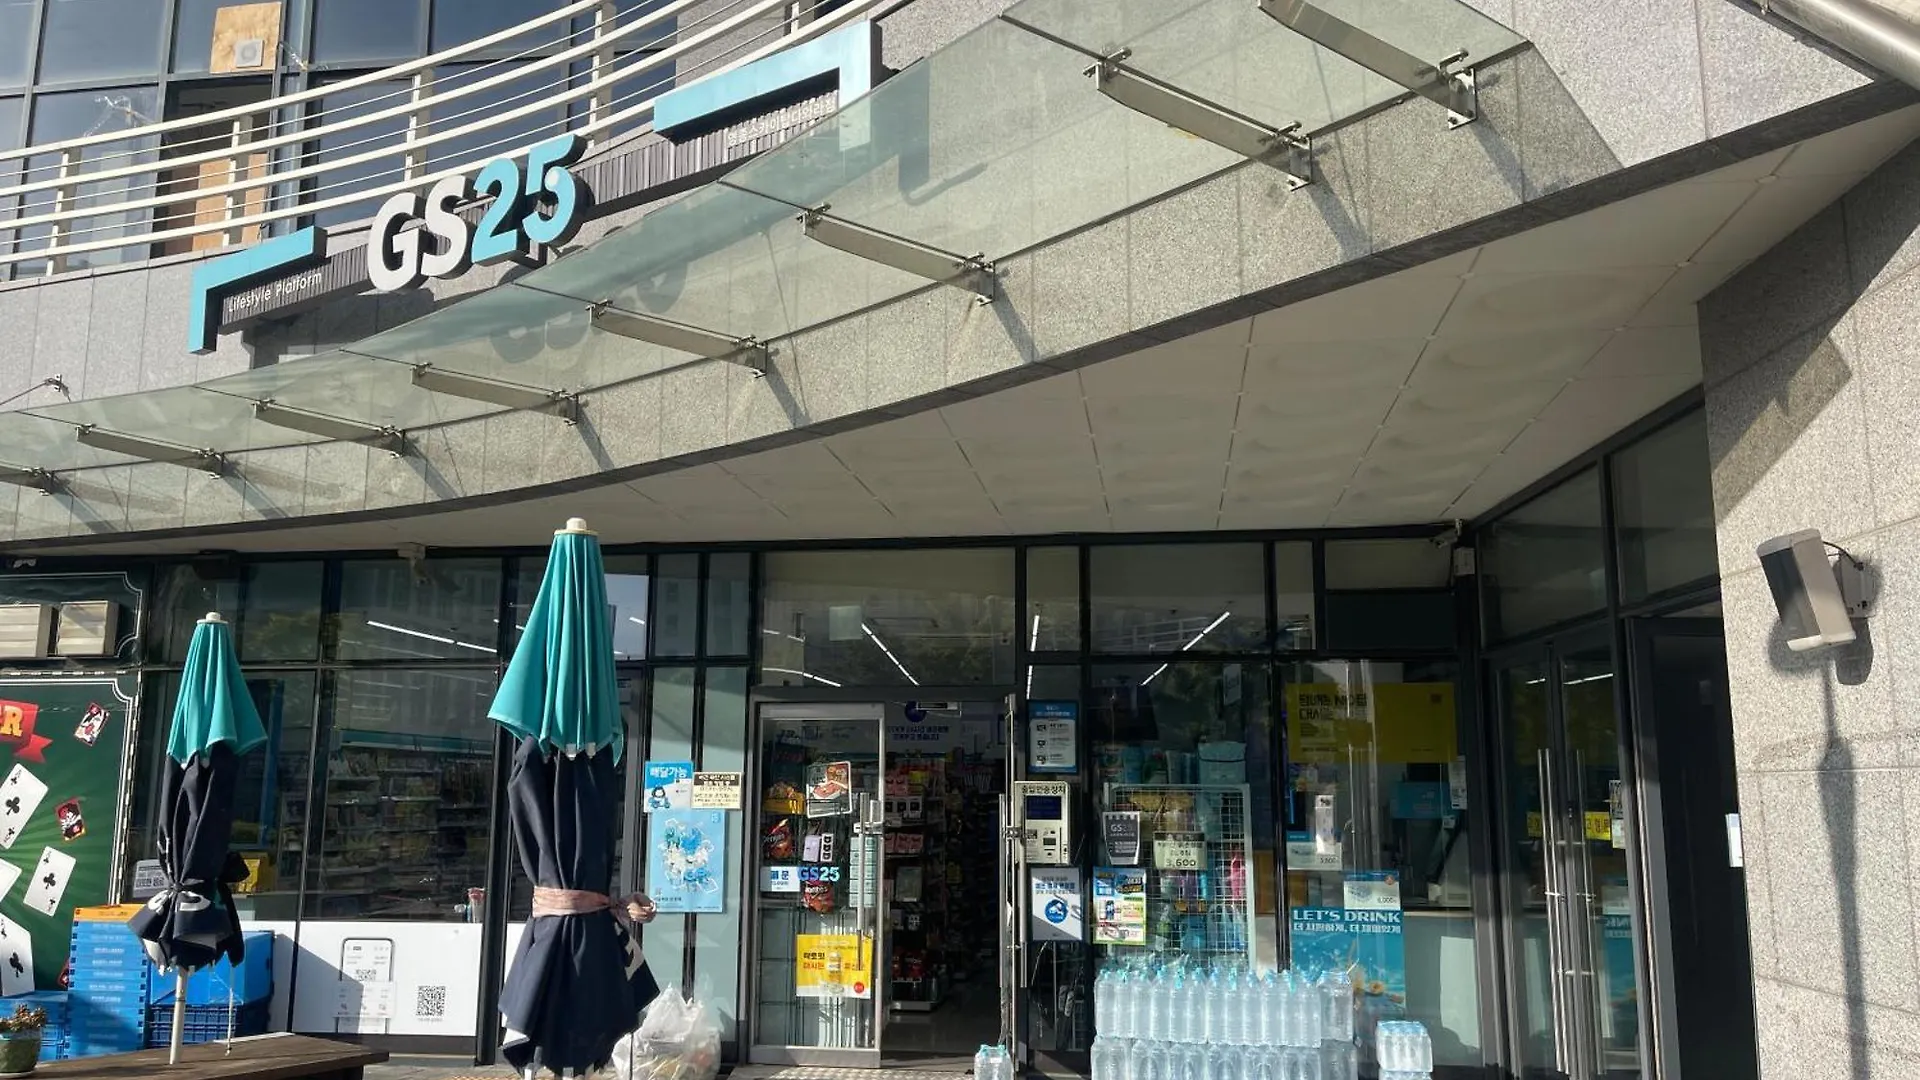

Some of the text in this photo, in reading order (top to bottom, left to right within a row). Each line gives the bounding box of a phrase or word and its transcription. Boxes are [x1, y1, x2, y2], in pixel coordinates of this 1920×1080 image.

[367, 133, 577, 292] GS25
[228, 272, 322, 312] Lifestyle Platform
[0, 704, 23, 737] R
[650, 766, 688, 778] 배달가능
[1165, 858, 1196, 868] 3,600
[797, 866, 840, 882] GS25
[1293, 909, 1401, 923] LET'S DRINK
